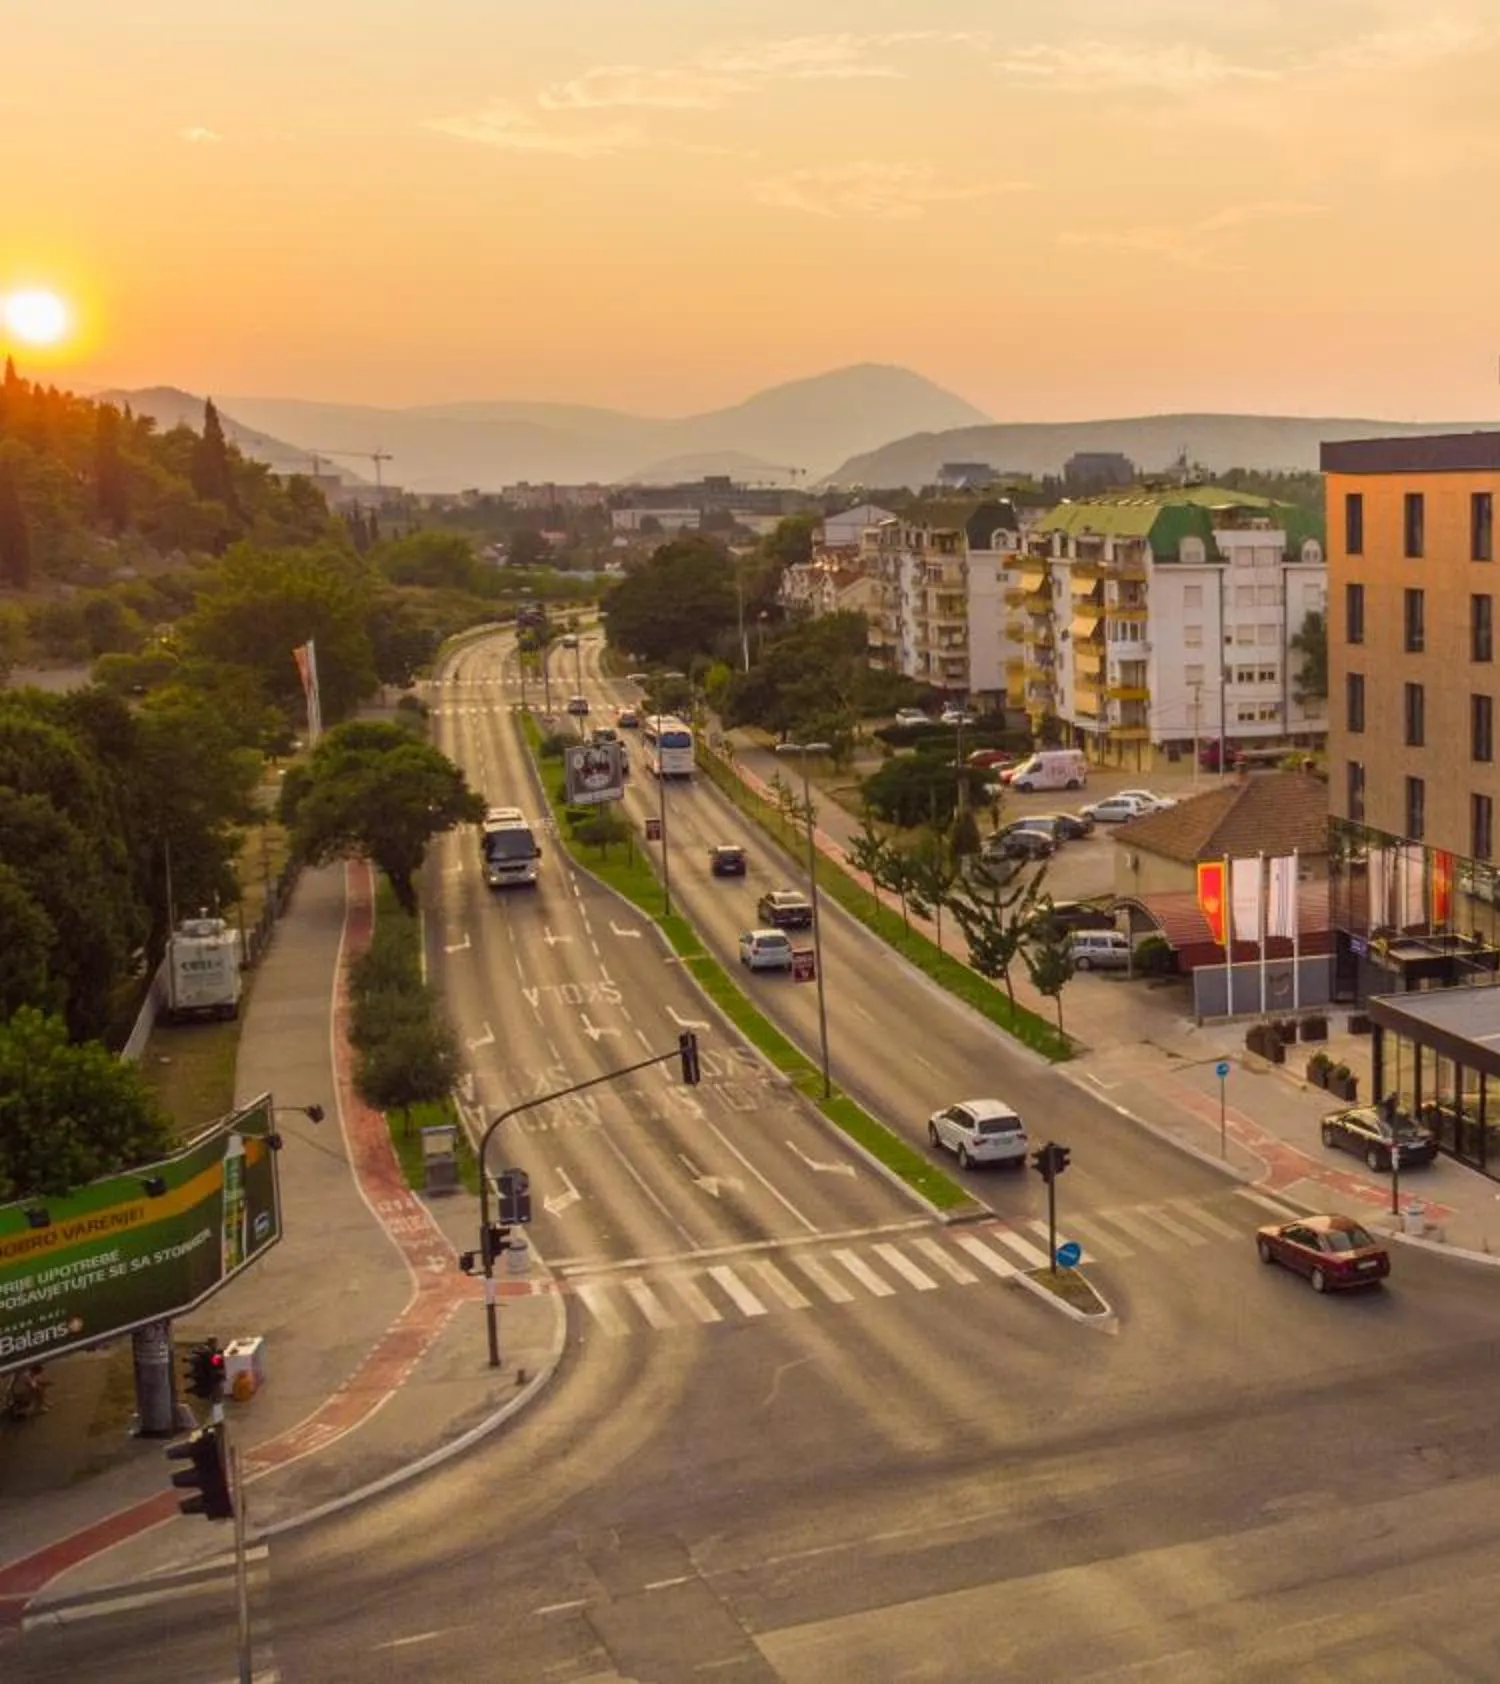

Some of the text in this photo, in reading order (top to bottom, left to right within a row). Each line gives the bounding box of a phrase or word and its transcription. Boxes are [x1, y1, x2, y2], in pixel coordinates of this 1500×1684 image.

[0, 1231, 58, 1257] OBRO
[0, 1249, 120, 1297] RIJE UPOTREBE
[108, 1262, 128, 1279] SE
[131, 1254, 151, 1273] SA
